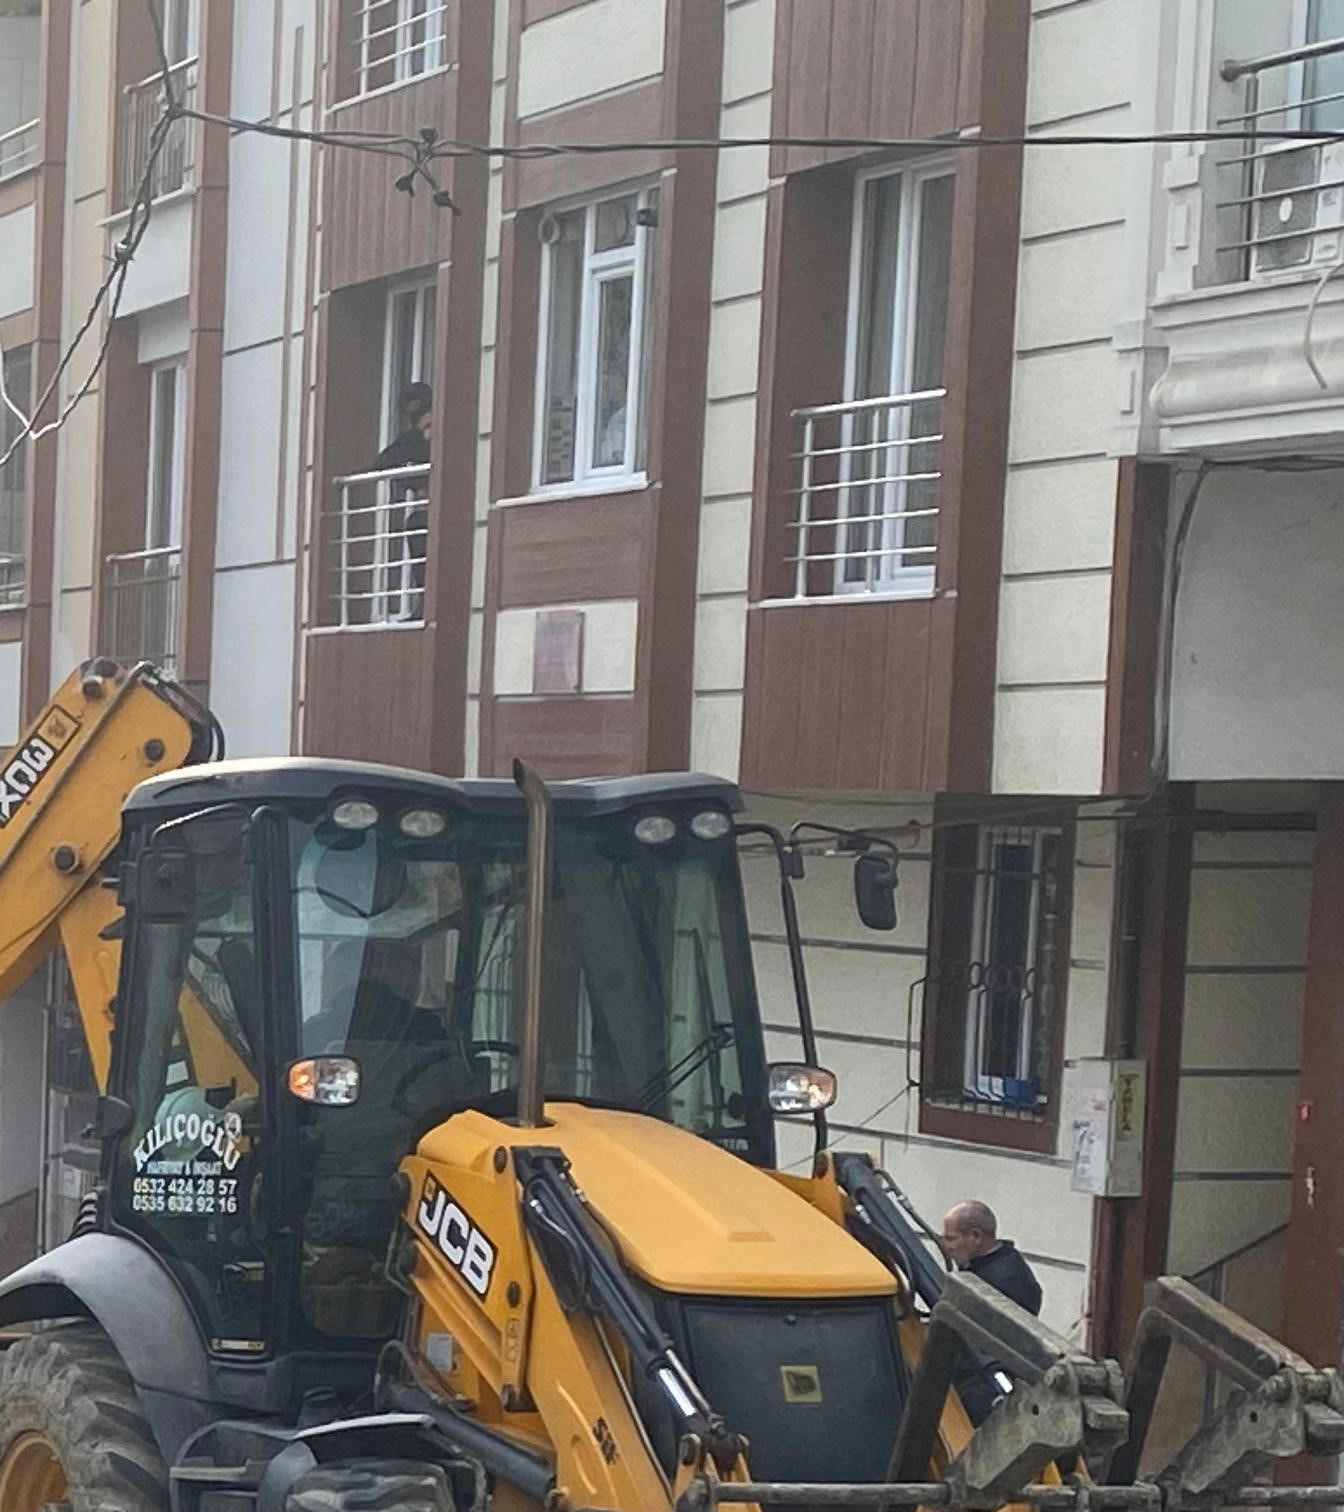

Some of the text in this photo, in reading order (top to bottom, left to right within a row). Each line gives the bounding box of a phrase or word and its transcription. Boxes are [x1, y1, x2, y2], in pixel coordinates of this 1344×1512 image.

[167, 1178, 194, 1195] 424
[218, 1178, 238, 1195] 57
[196, 1195, 215, 1212] 92
[218, 1196, 238, 1213] 16
[418, 1190, 494, 1294] JCB
